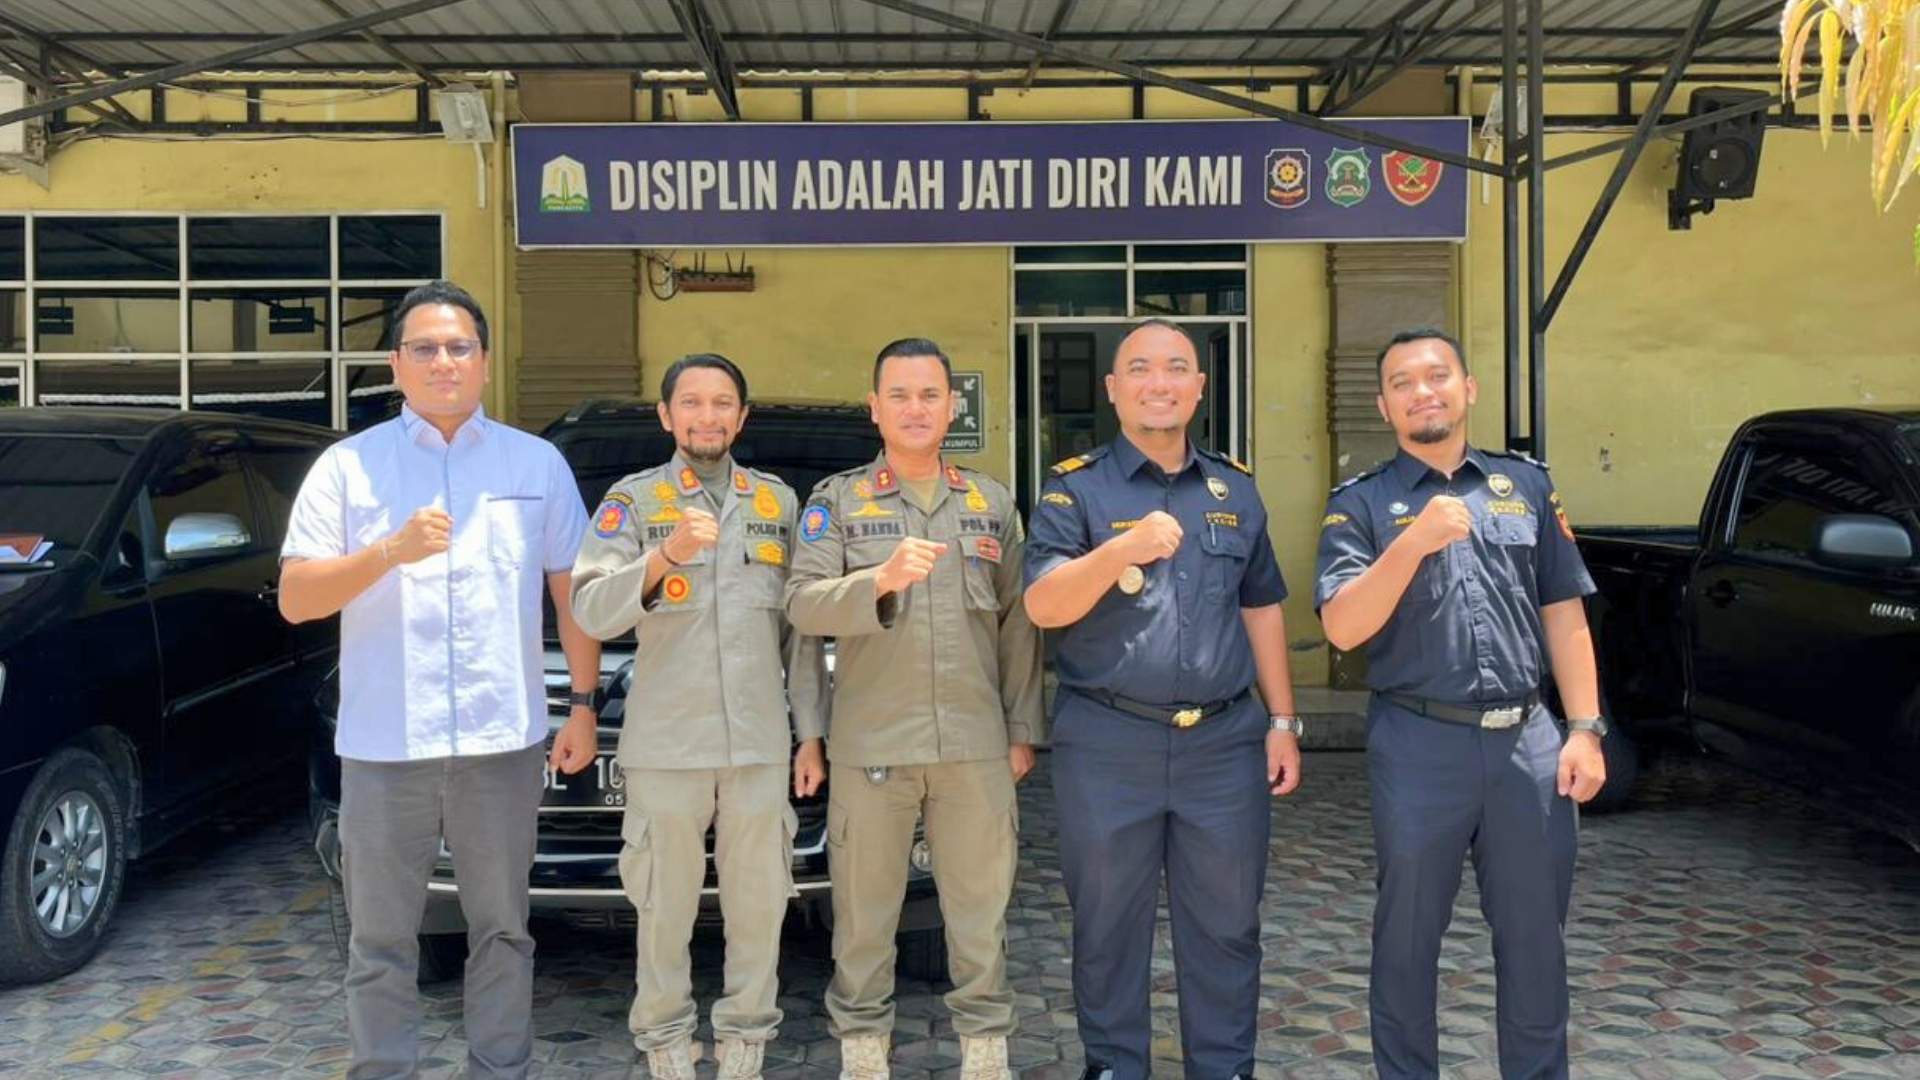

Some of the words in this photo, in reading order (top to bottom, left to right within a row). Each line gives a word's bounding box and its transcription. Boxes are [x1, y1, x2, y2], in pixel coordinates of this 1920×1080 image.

[609, 160, 777, 211] DISIPLIN
[793, 159, 945, 211] ADALAH
[958, 158, 1033, 210] JATI
[1048, 157, 1129, 210] DIRI
[1145, 155, 1242, 208] KAMI
[647, 525, 676, 540] RU
